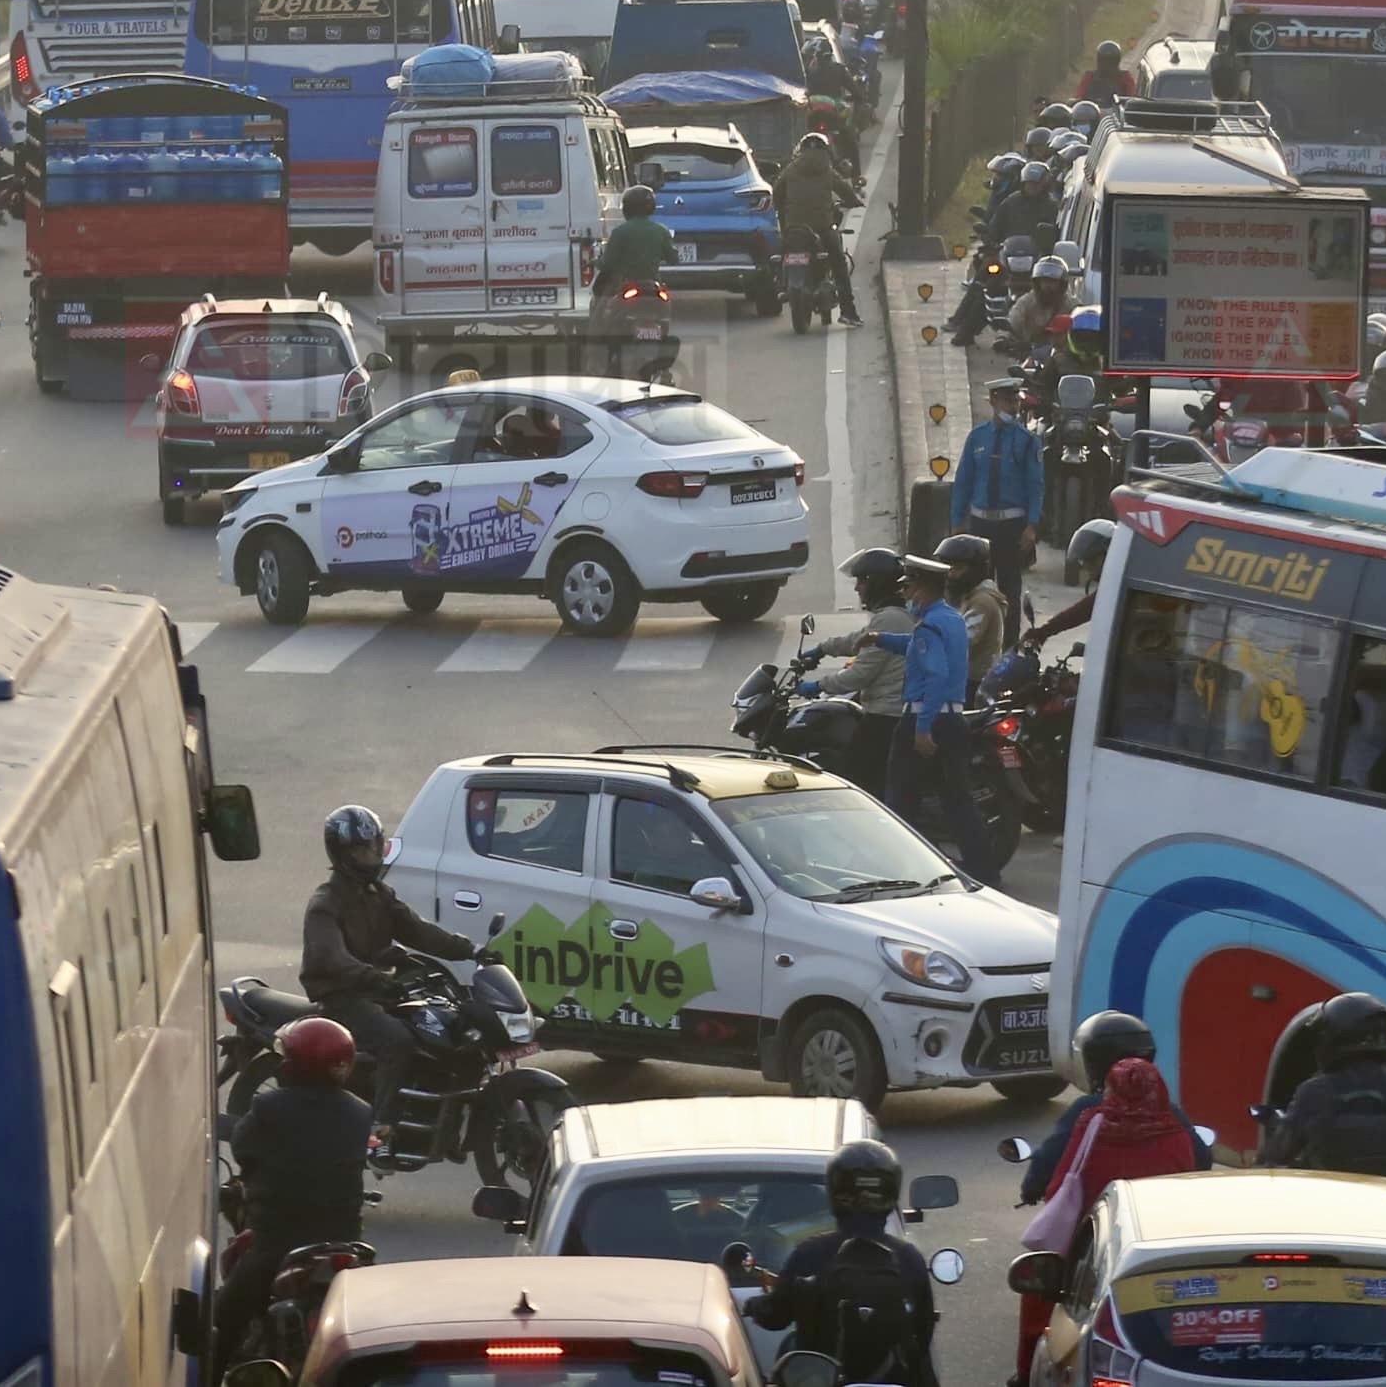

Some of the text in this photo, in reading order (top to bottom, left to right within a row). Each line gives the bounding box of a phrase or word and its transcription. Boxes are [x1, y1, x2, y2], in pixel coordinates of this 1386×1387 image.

[67, 20, 167, 35] TOUR & TRAVELS
[1176, 298, 1218, 311] KNOW
[1222, 300, 1247, 312] THE
[1183, 317, 1224, 327] AVOID
[1229, 317, 1254, 327] THE
[1171, 332, 1222, 344] IGNORE
[1227, 333, 1251, 344] THE
[1182, 348, 1224, 360] KNOW
[1229, 349, 1253, 361] THE
[215, 425, 324, 436] Don't Touch Me
[444, 513, 522, 554] XTREME
[451, 541, 516, 566] ENERGY DRINK
[1185, 537, 1330, 601] Smriti
[513, 929, 684, 999] inDrive
[998, 1049, 1050, 1067] SUZU
